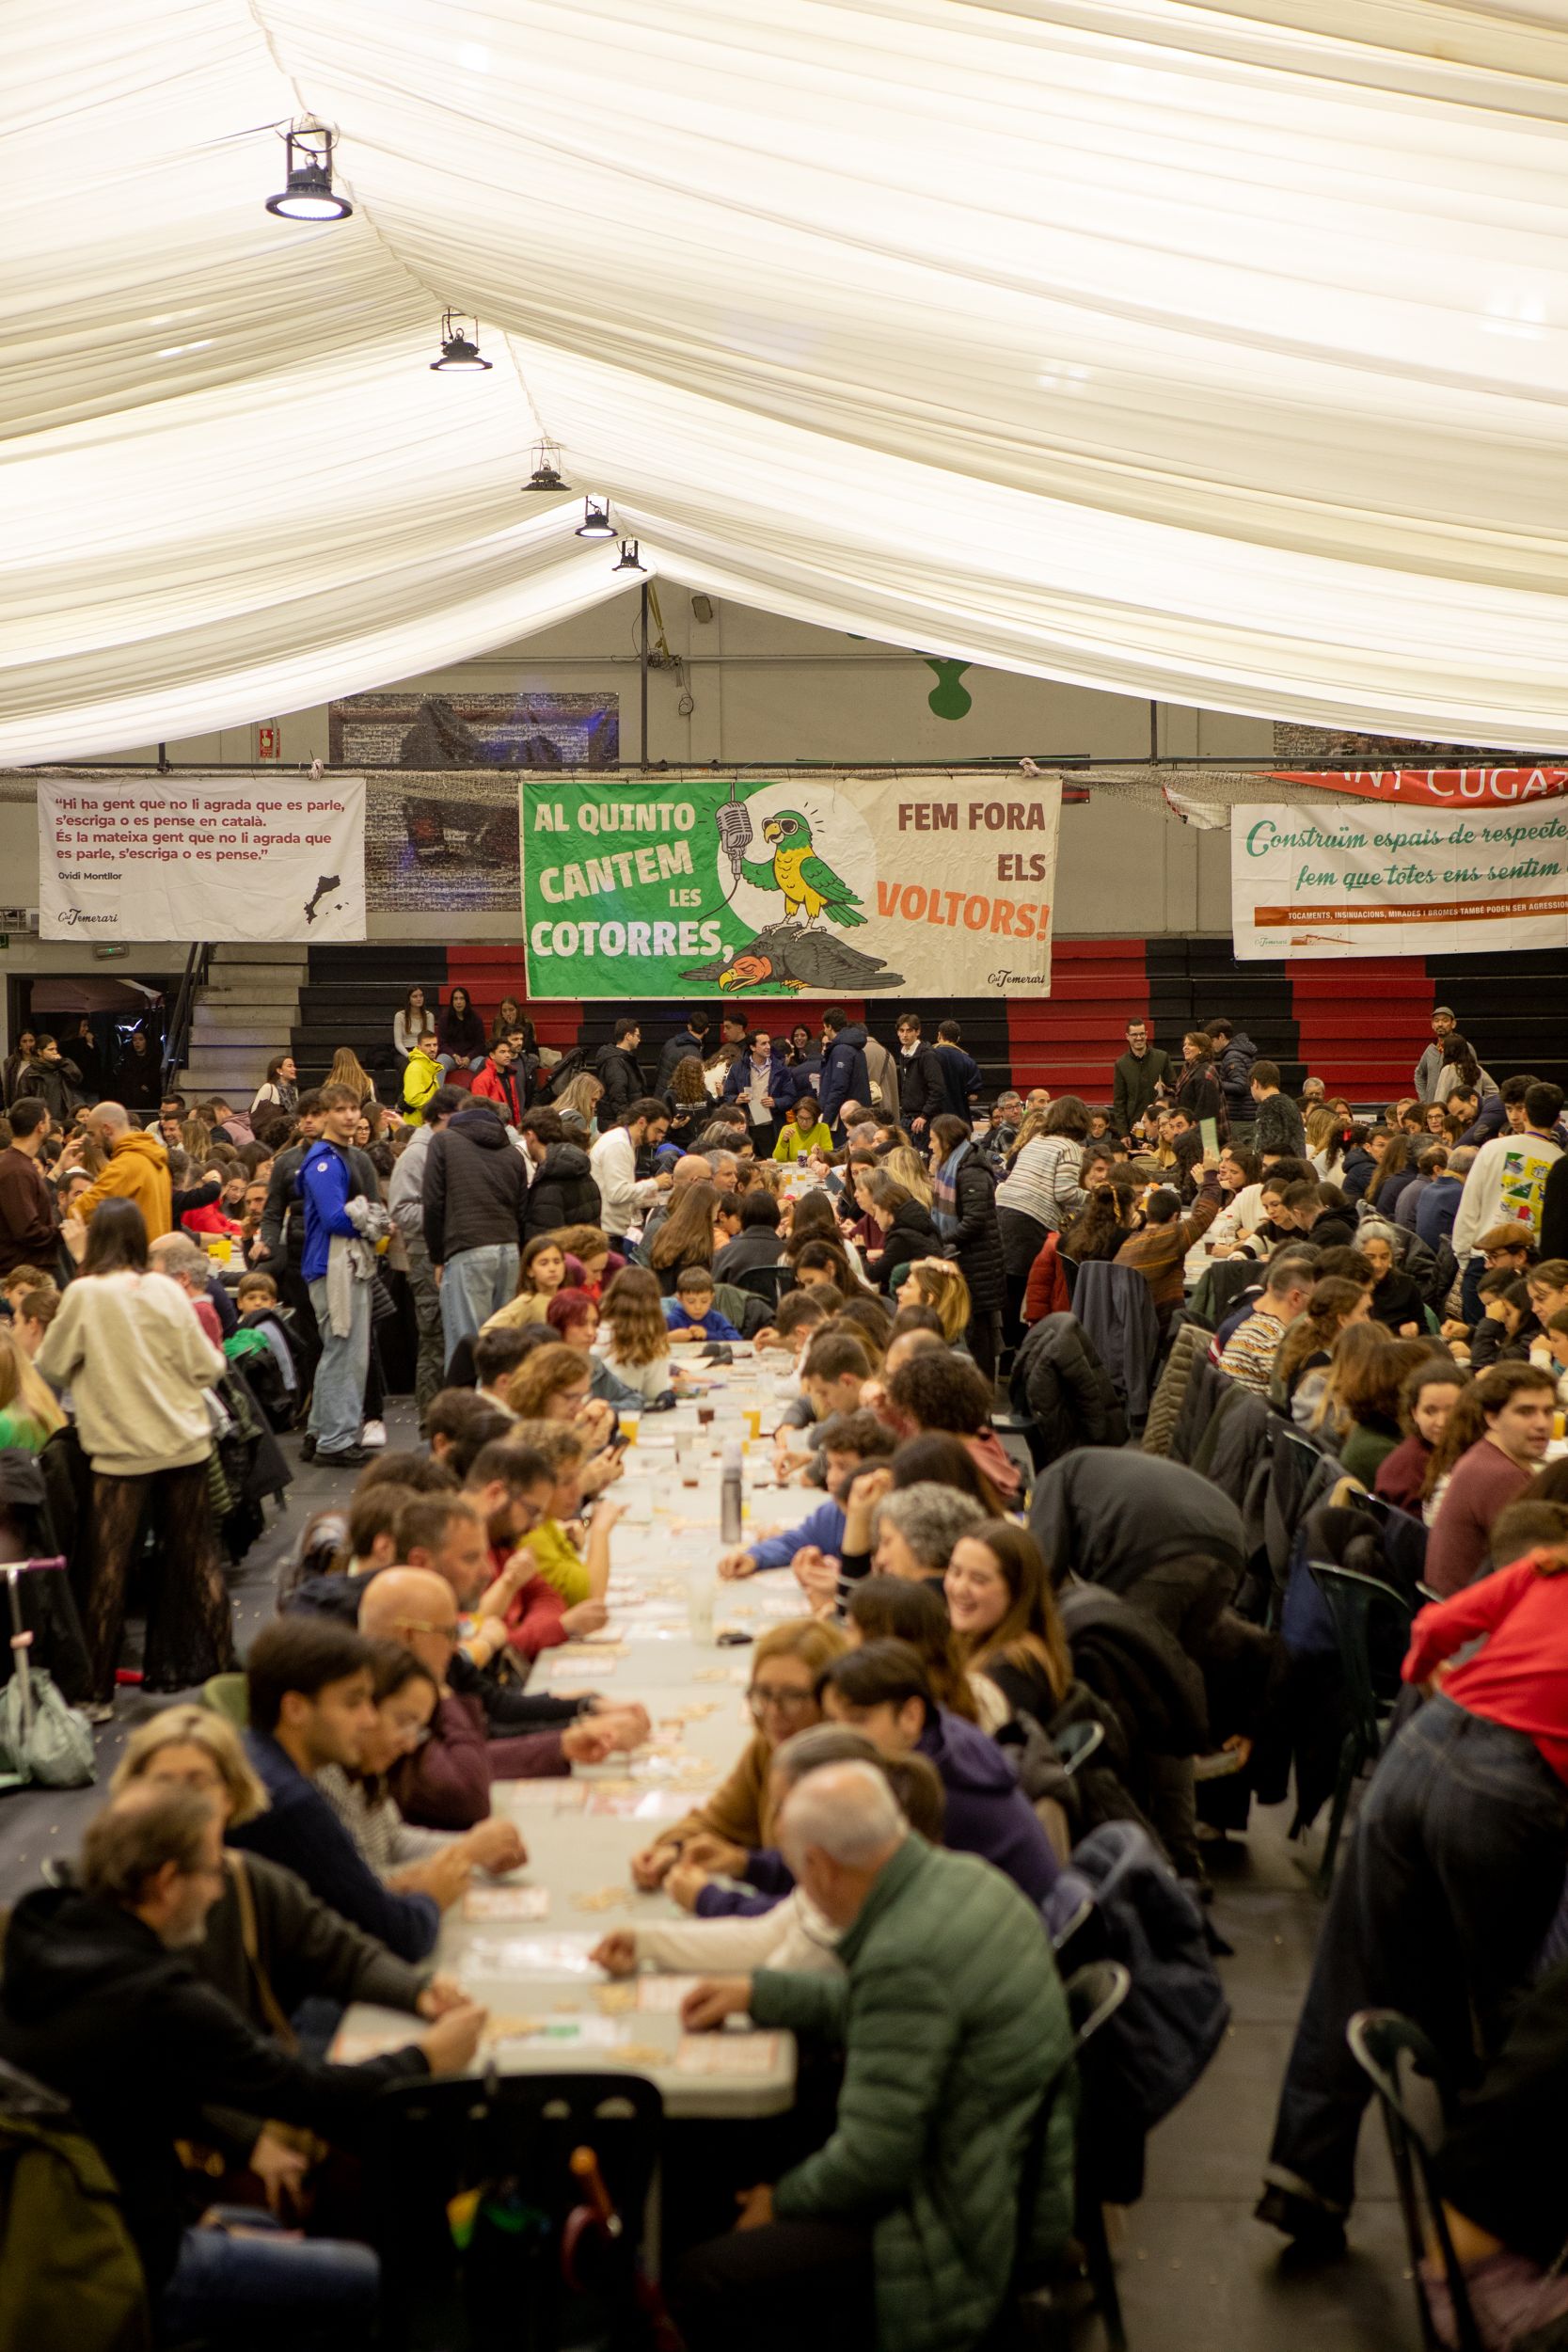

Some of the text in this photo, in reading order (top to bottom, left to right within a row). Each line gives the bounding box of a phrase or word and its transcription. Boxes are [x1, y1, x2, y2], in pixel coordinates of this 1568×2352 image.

[55, 798, 345, 813] “Hi ha gent que no li agrada que es parle,
[55, 815, 266, 828] s’escriga o es pense en català.
[534, 803, 695, 836] AL QUINTO
[899, 802, 1046, 831] FEM FORA
[56, 829, 332, 846] És la mateixa gent que no li agrada que
[1246, 820, 1368, 857] Construïm
[1374, 828, 1443, 853] espais
[1448, 823, 1476, 844] de
[57, 848, 268, 862] es parle, s’escriga o es pense.”
[58, 871, 81, 879] Ovidi
[539, 840, 694, 904] CANTEM
[998, 854, 1046, 882] ELS
[1296, 865, 1338, 891] fem
[1343, 872, 1383, 891] que
[1383, 864, 1437, 885] totes
[1443, 867, 1483, 882] ens
[1488, 858, 1561, 880] sentim
[669, 889, 702, 907] LES
[68, 908, 118, 925] Temerari
[877, 881, 1050, 941] VOLTORS!
[1460, 906, 1484, 915] TAMBÉ
[1487, 905, 1510, 914] PODEN
[531, 921, 734, 963] COTORRES,
[997, 970, 1045, 987] Temerari
